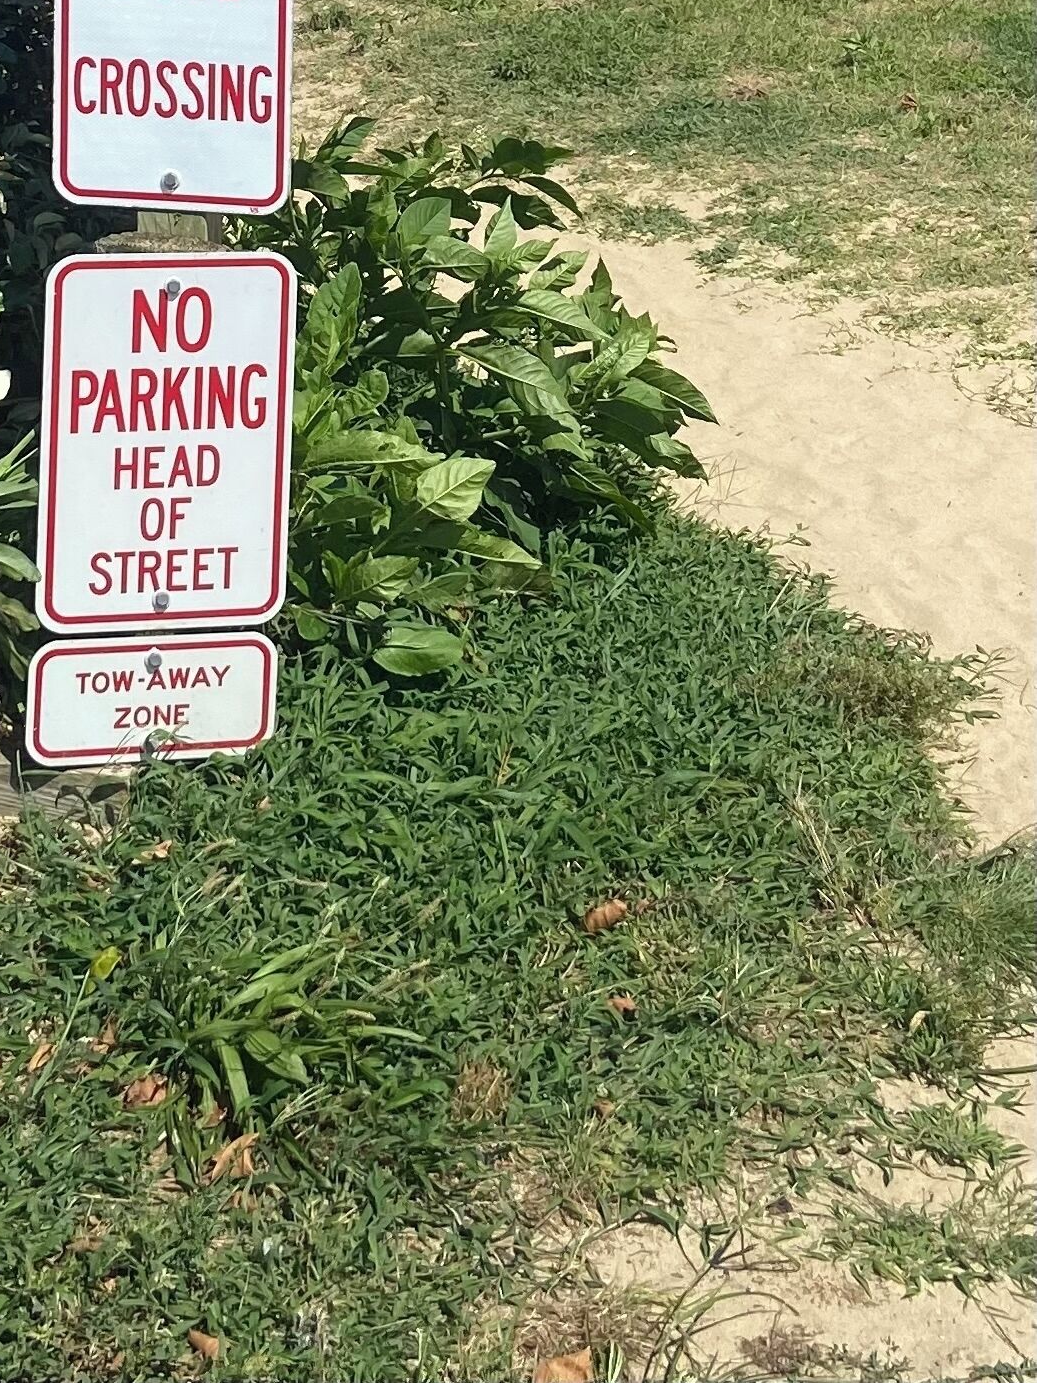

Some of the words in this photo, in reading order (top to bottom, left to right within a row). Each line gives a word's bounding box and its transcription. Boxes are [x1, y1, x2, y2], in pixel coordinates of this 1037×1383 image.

[74, 56, 273, 124] CROSSING
[132, 287, 212, 353] NO
[70, 363, 267, 434] PARKING
[114, 445, 221, 490] HEAD
[140, 497, 192, 541] OF
[89, 547, 238, 595] STREET
[76, 665, 231, 694] TOW-AWAY
[113, 704, 190, 729] ZONE
